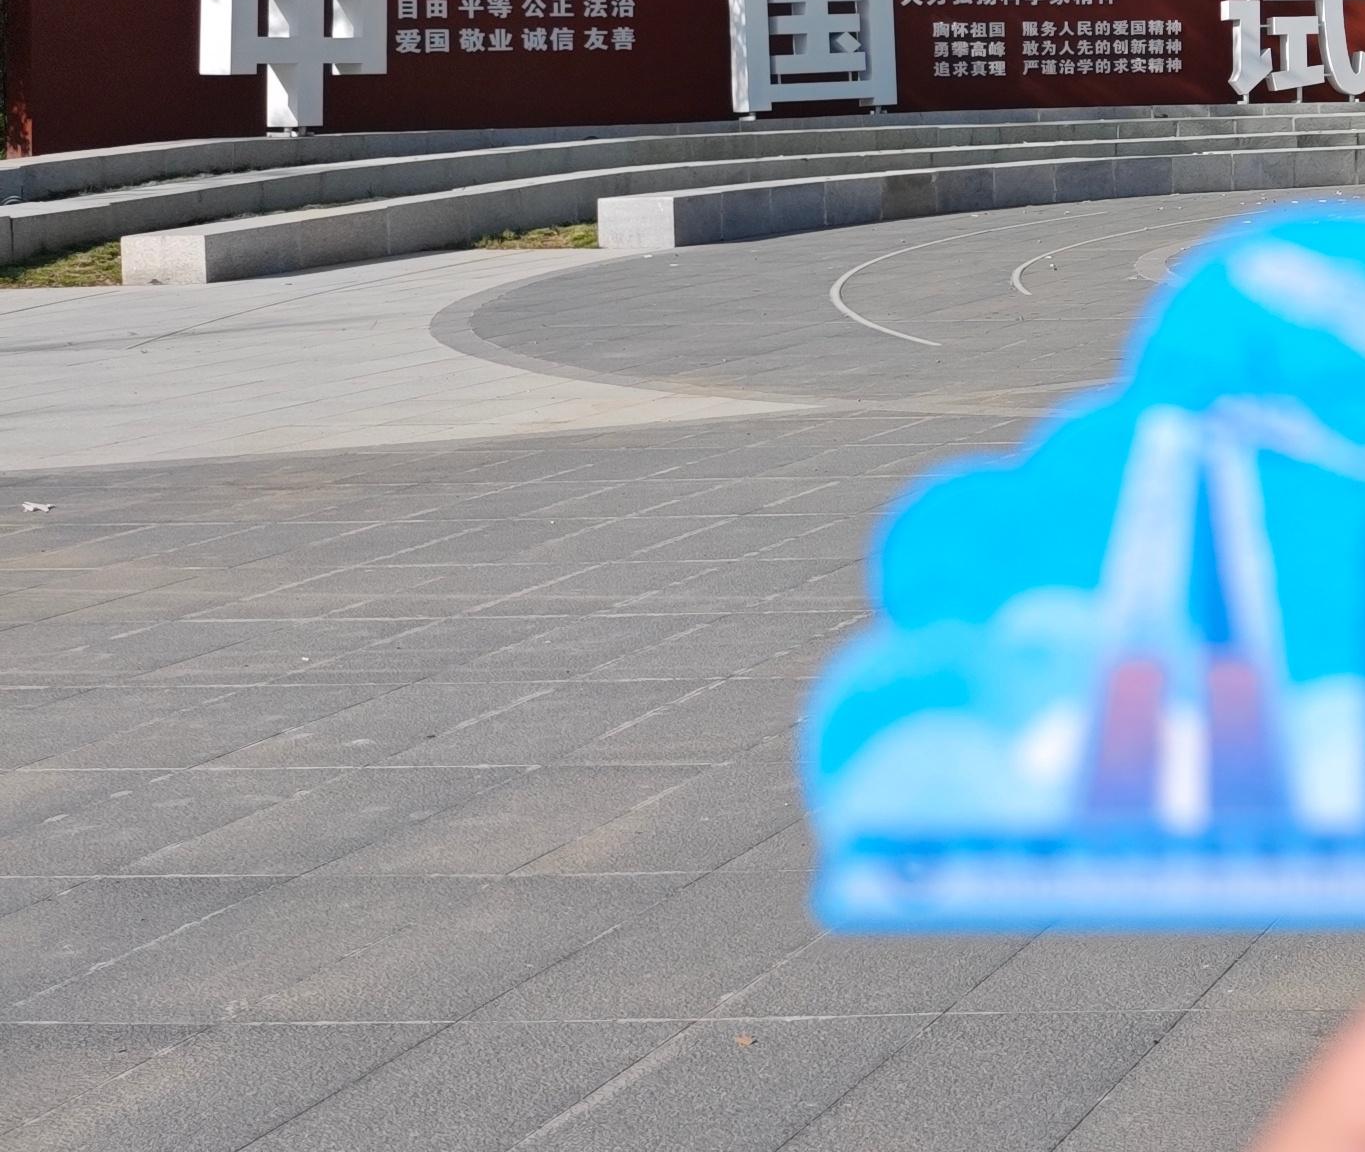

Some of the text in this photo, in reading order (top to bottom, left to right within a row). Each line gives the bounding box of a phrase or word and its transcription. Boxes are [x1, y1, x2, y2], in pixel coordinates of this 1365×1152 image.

[932, 19, 1182, 38] 胸怀祖国 服务人民的爱国精神
[395, 27, 636, 54] 爱国 敬业 诚信 友善
[933, 39, 1183, 58] 勇攀高峰 敢为人先的创新精神
[933, 58, 1183, 77] 追求真理 严谨治学的求实精神
